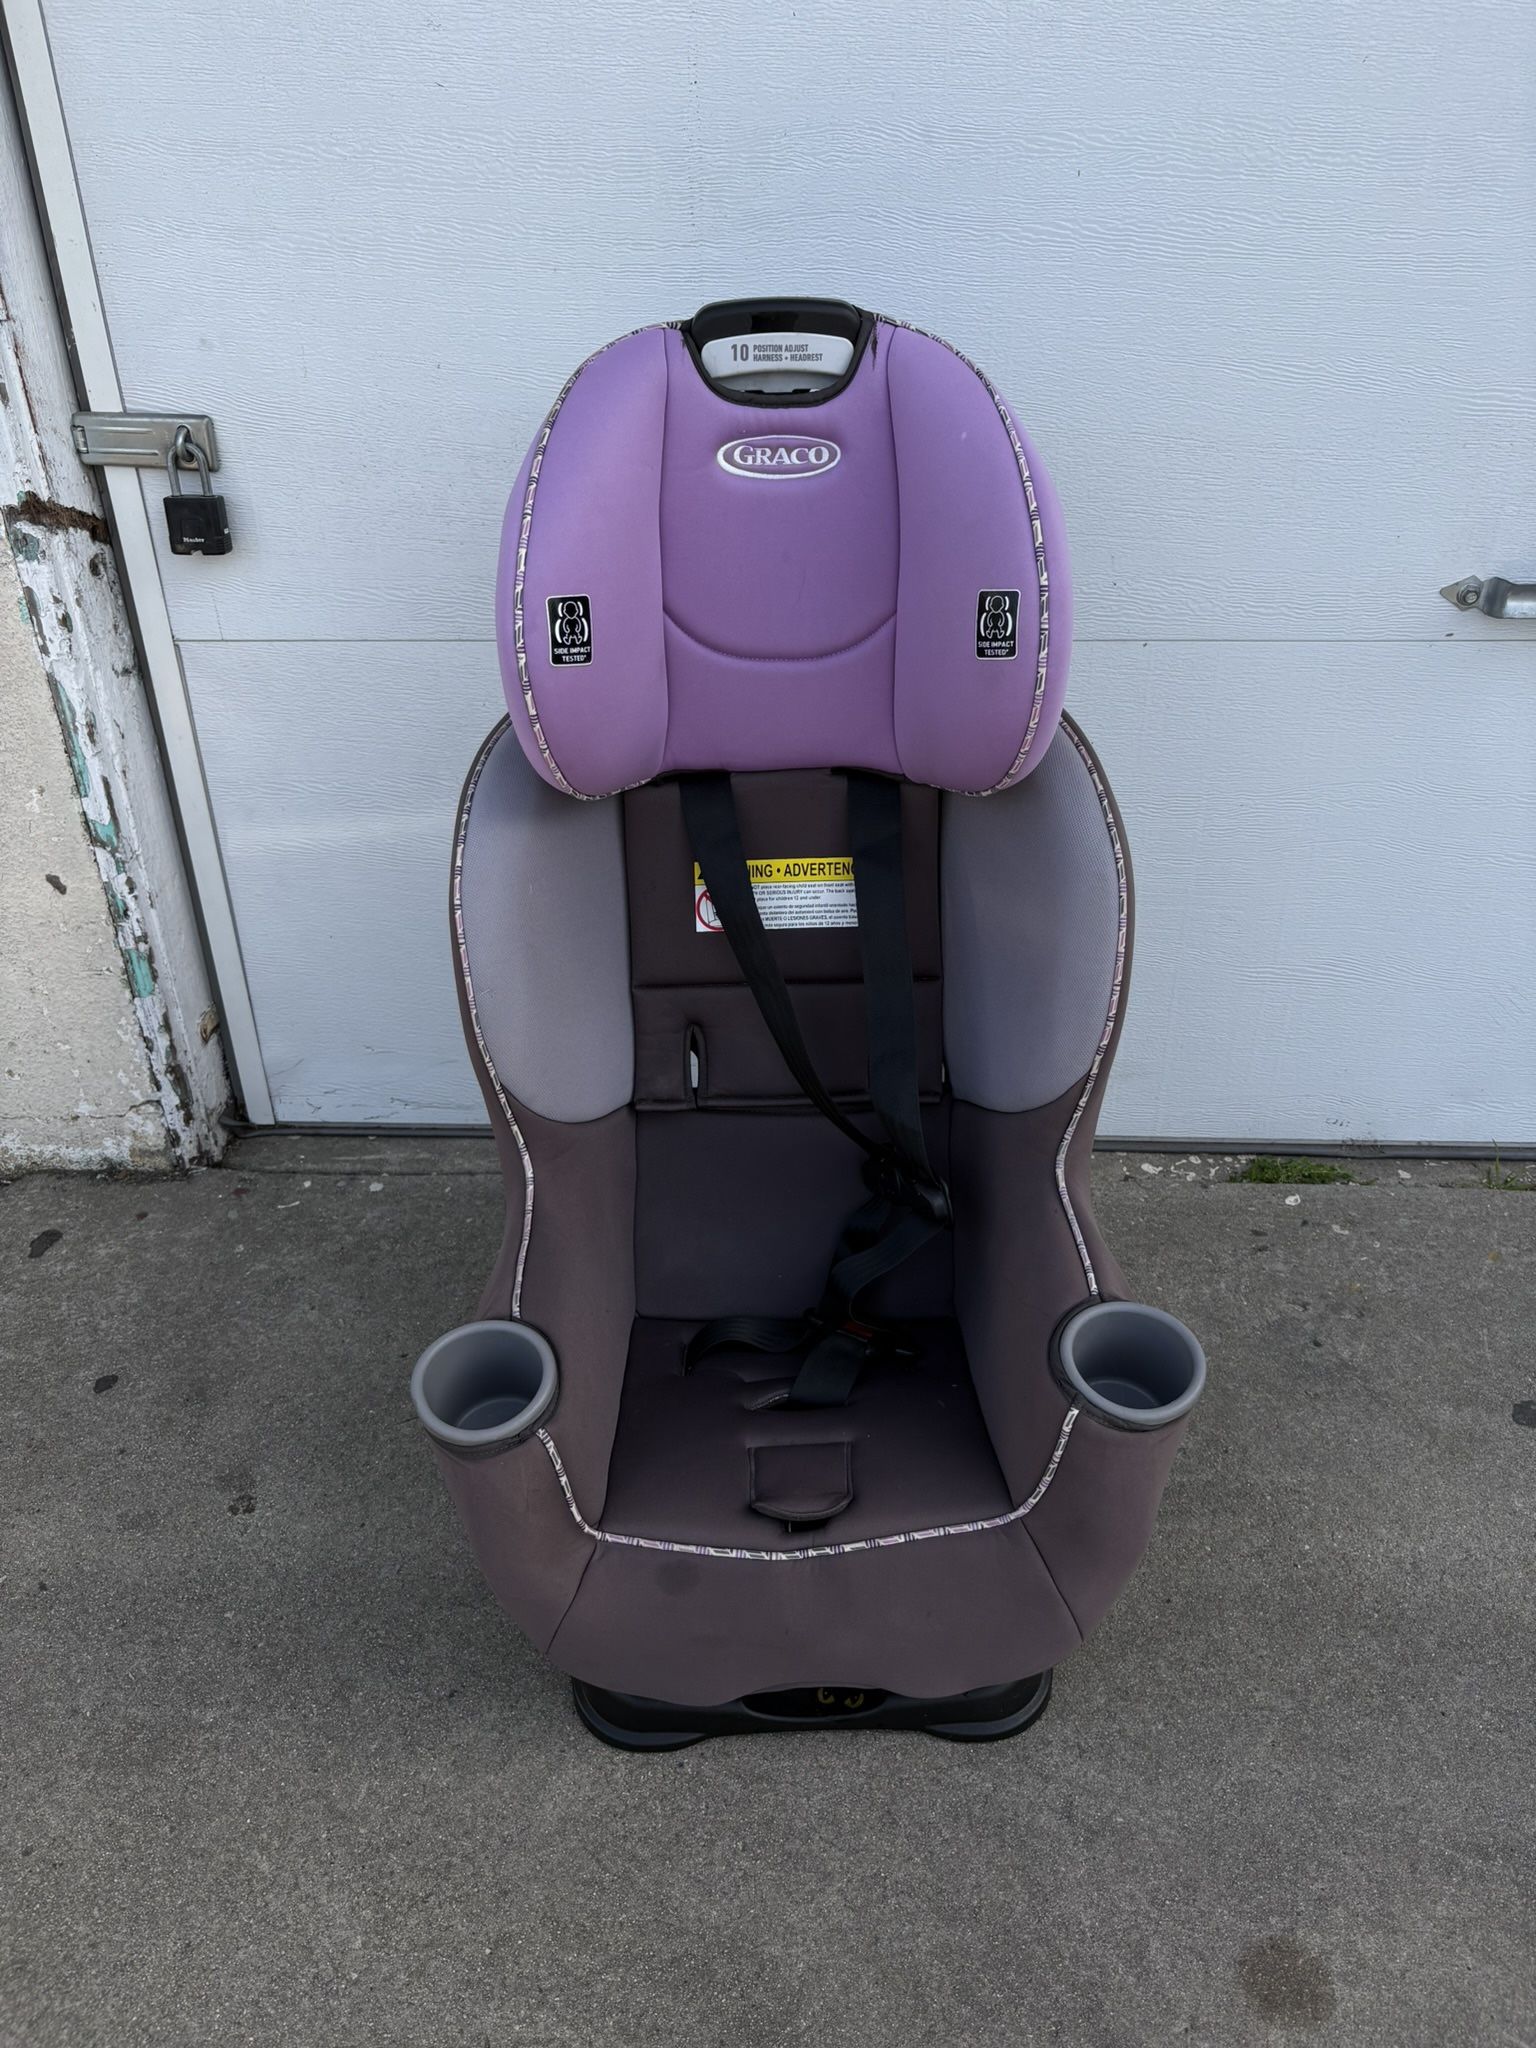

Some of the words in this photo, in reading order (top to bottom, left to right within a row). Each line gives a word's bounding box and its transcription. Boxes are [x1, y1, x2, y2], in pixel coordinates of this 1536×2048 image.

[731, 344, 749, 361] 10
[753, 344, 783, 353] POSITION
[784, 344, 809, 353] ADJUST
[753, 354, 783, 362] HARNESS
[790, 353, 823, 362] HEADREST
[733, 445, 829, 466] GRACO
